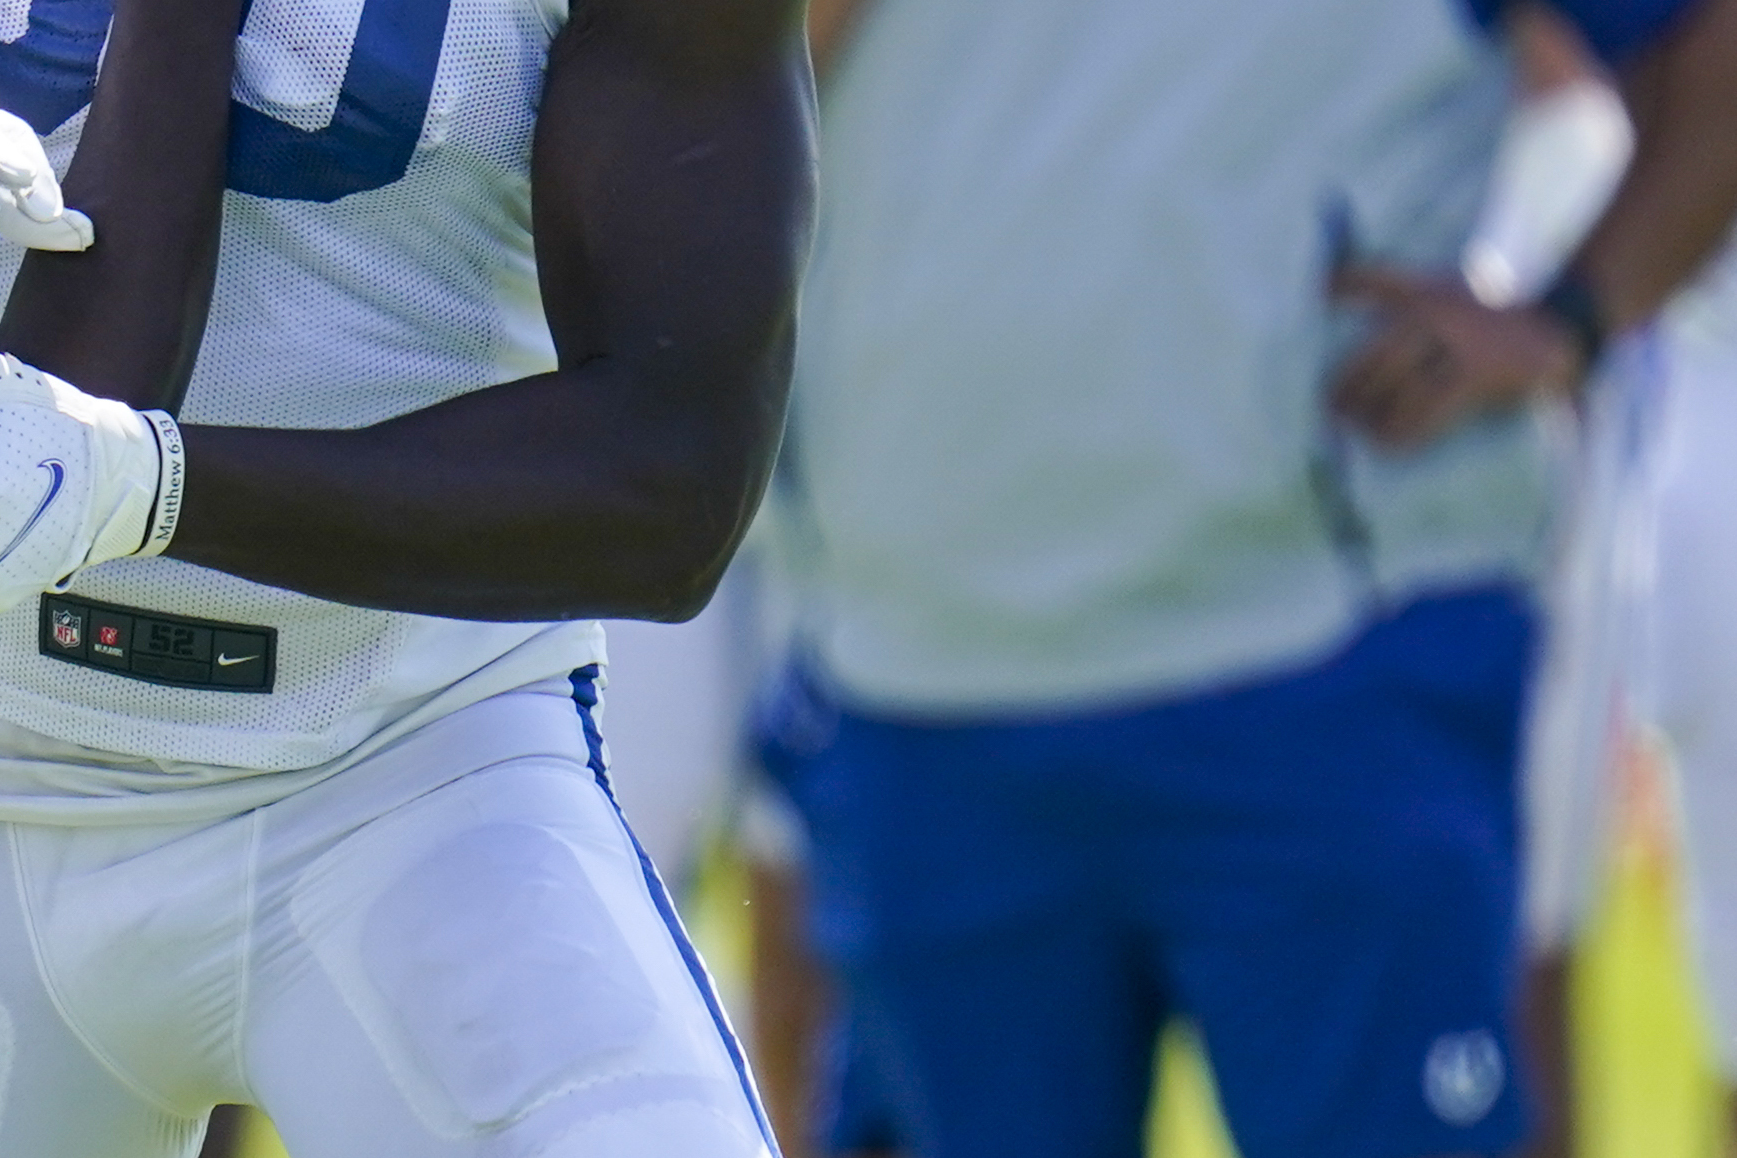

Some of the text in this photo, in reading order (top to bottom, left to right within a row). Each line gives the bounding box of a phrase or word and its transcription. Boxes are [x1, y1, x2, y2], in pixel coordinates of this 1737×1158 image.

[155, 419, 182, 540] Matthew 6:33
[56, 626, 76, 642] NFL
[149, 624, 194, 655] 52
